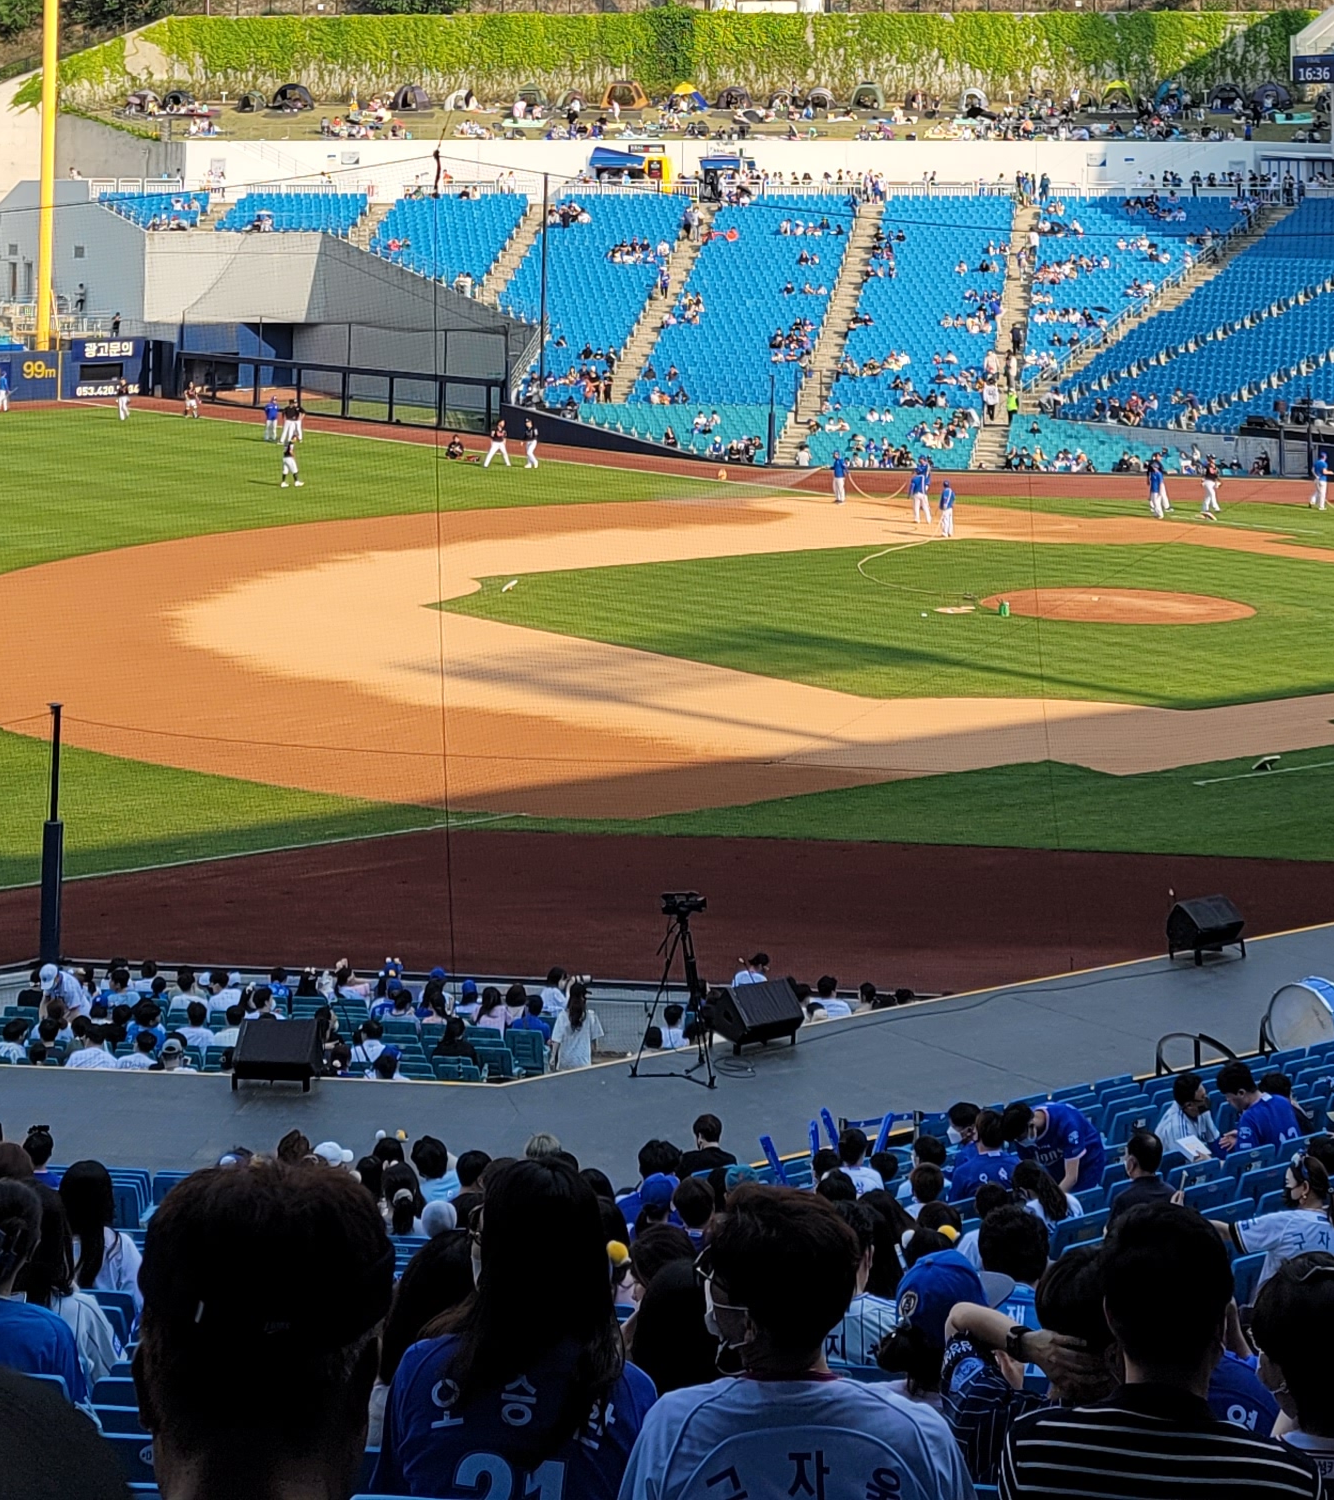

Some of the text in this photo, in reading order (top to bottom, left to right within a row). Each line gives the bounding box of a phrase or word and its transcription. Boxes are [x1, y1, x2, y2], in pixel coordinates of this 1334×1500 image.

[1298, 67, 1331, 81] 16:36
[84, 341, 134, 357] 광고문의
[22, 361, 56, 379] 99m
